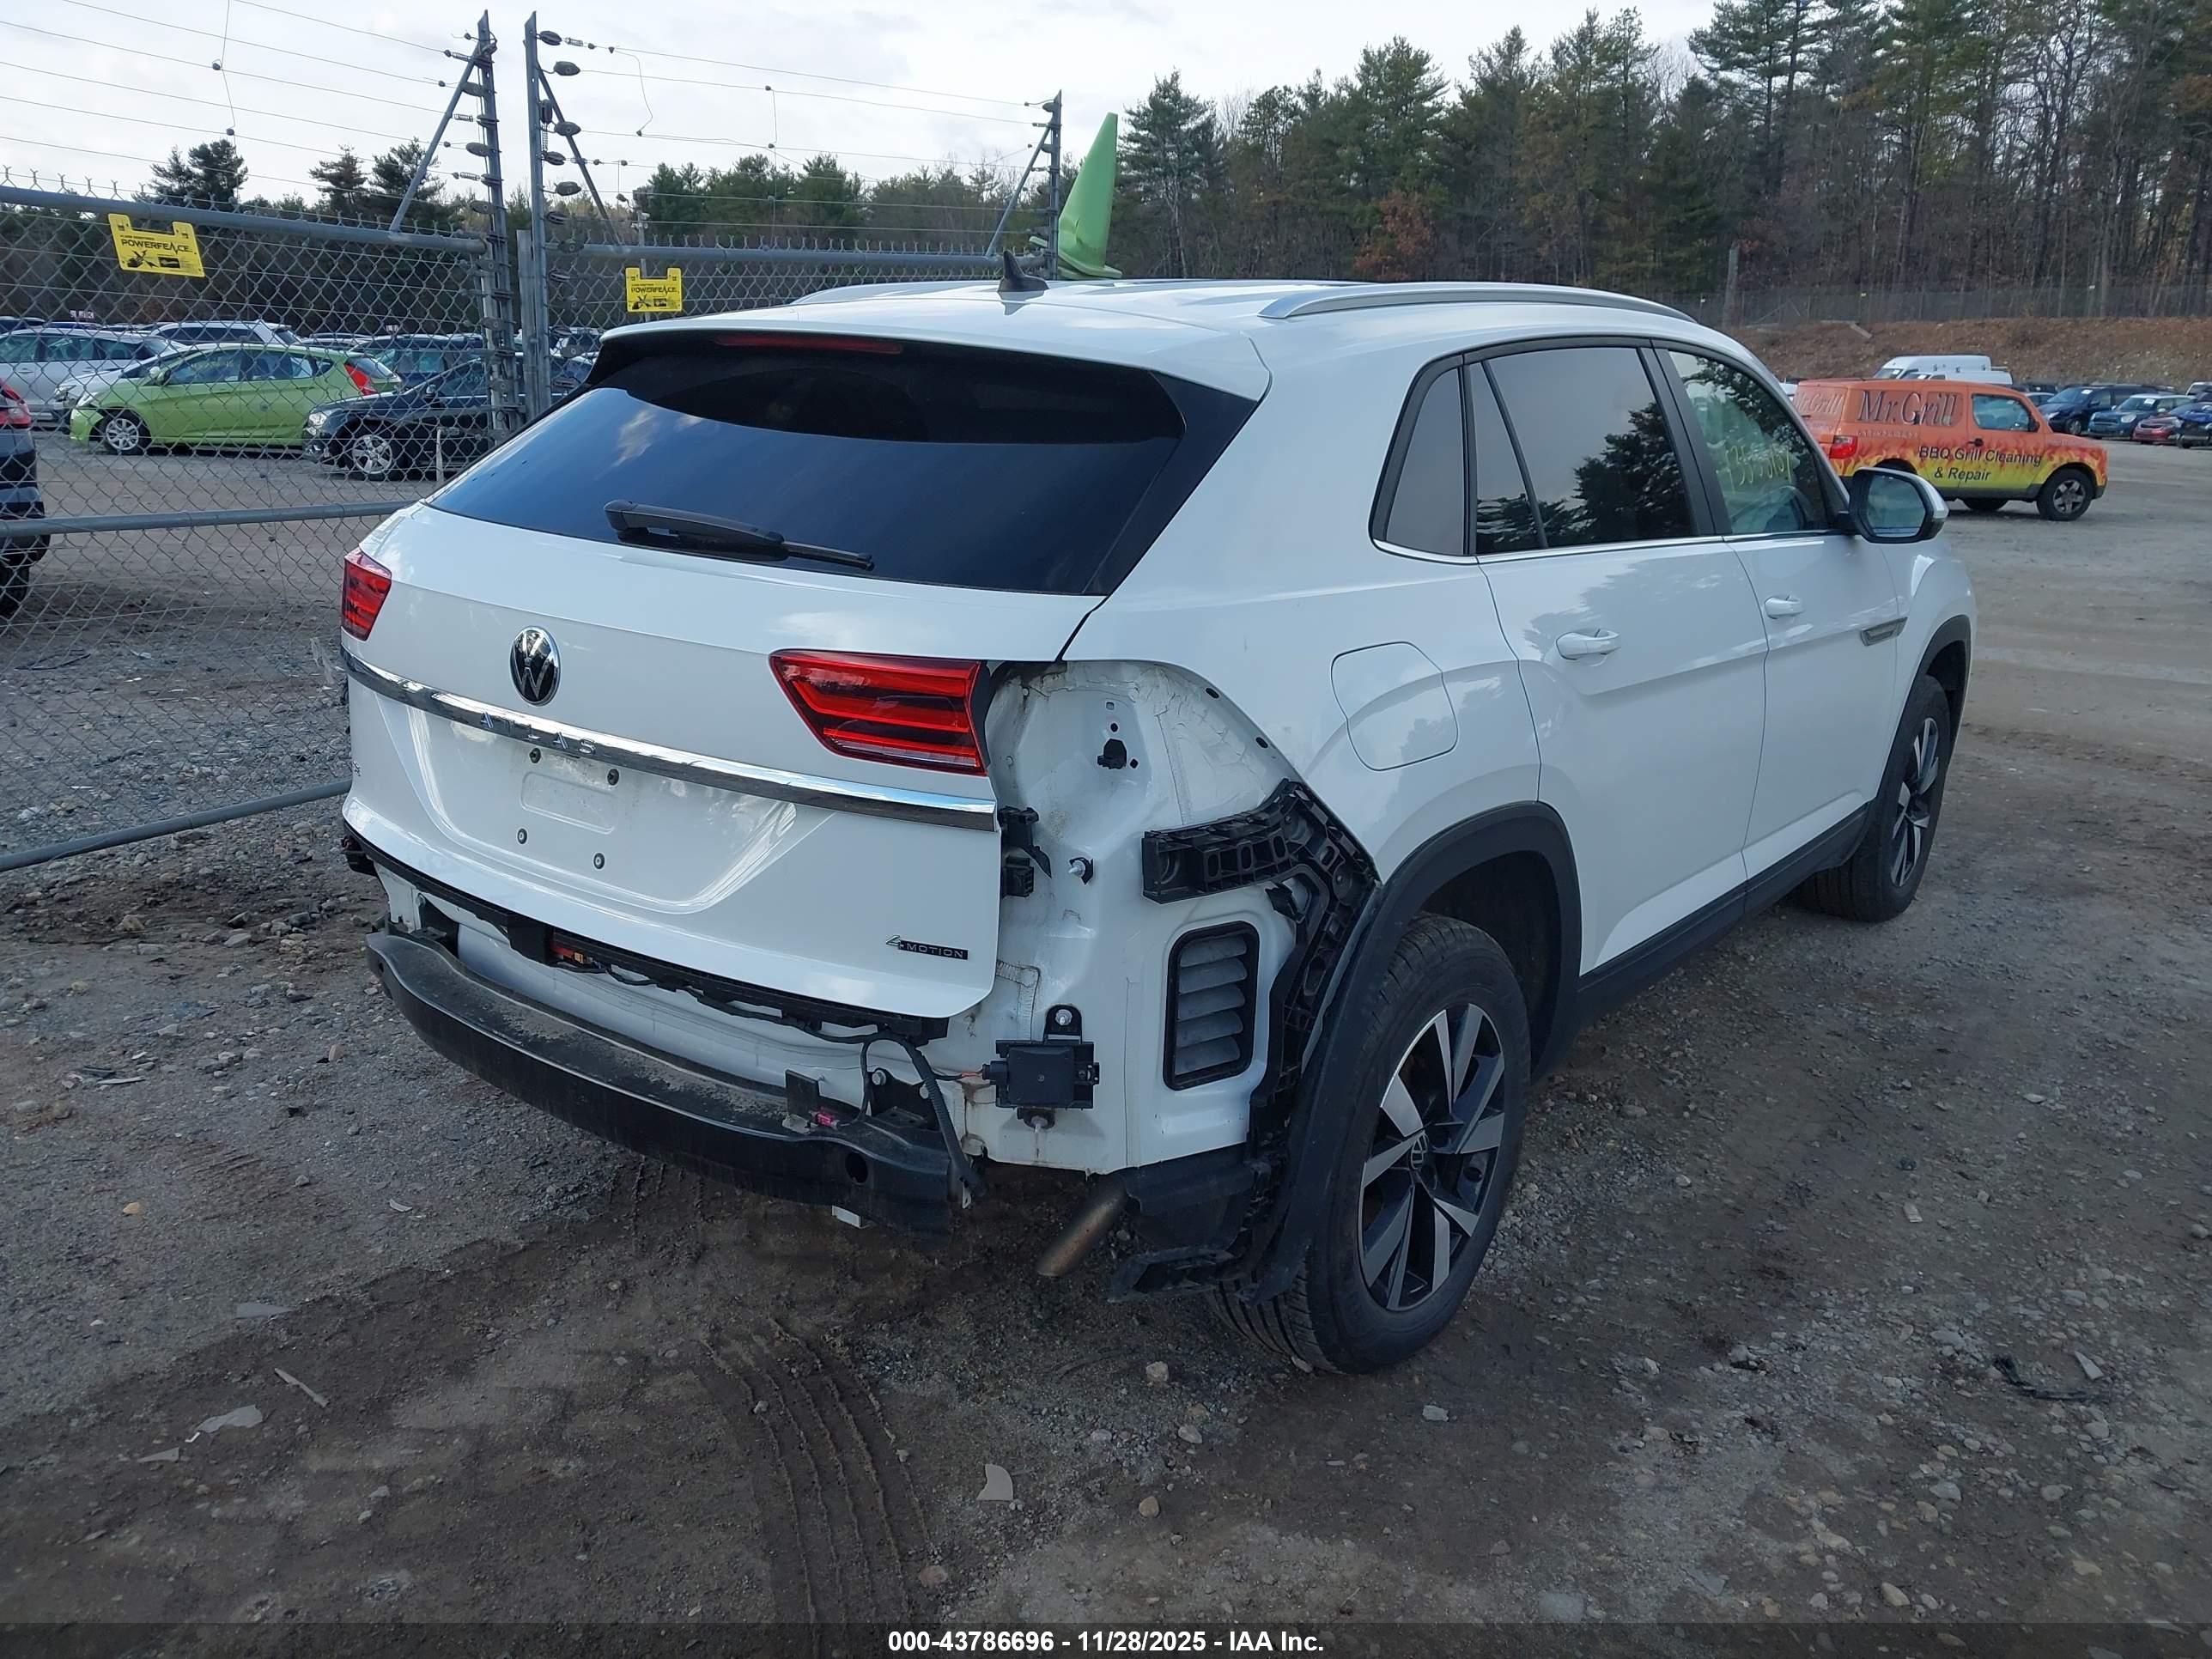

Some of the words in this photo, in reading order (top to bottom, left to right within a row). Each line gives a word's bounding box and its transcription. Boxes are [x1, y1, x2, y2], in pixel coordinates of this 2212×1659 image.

[1901, 391, 1958, 427] Grill
[1918, 446, 1951, 459] BBQ
[1954, 447, 1982, 462] Grill
[1985, 449, 2042, 467] Cleaning
[1934, 466, 1943, 479] &
[1948, 467, 1991, 483] Repair
